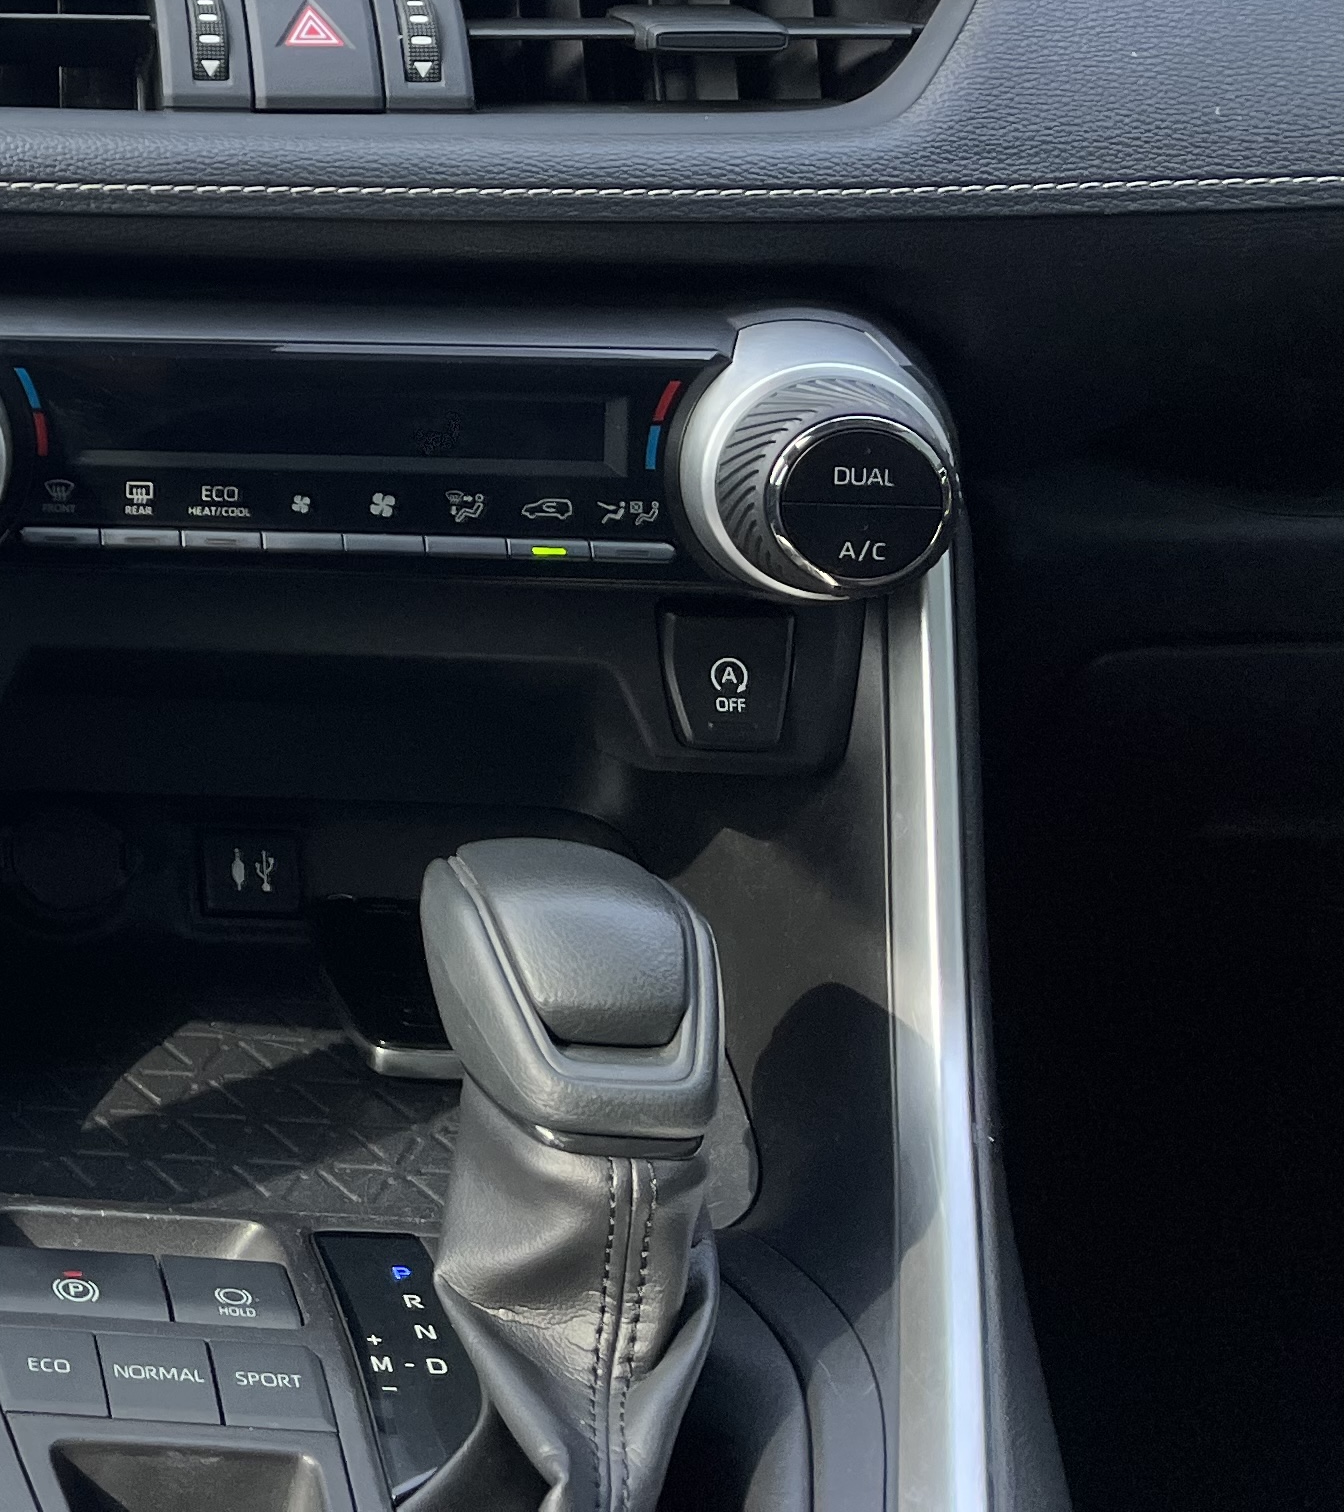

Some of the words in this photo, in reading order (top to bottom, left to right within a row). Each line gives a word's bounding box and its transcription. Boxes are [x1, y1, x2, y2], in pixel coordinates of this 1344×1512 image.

[833, 466, 895, 486] DUAL
[201, 485, 239, 502] ECO
[124, 505, 153, 515] REAR
[187, 506, 251, 517] HEAT/COOL
[838, 540, 886, 562] A/C
[715, 696, 746, 713] OFF
[392, 1266, 411, 1280] P
[402, 1294, 425, 1309] R
[218, 1306, 257, 1318] HOLD
[414, 1324, 438, 1340] N
[27, 1356, 71, 1374] ECO
[370, 1355, 394, 1373] M
[425, 1357, 449, 1375] D
[113, 1363, 205, 1383] NORMAL
[234, 1371, 302, 1388] SPORT
